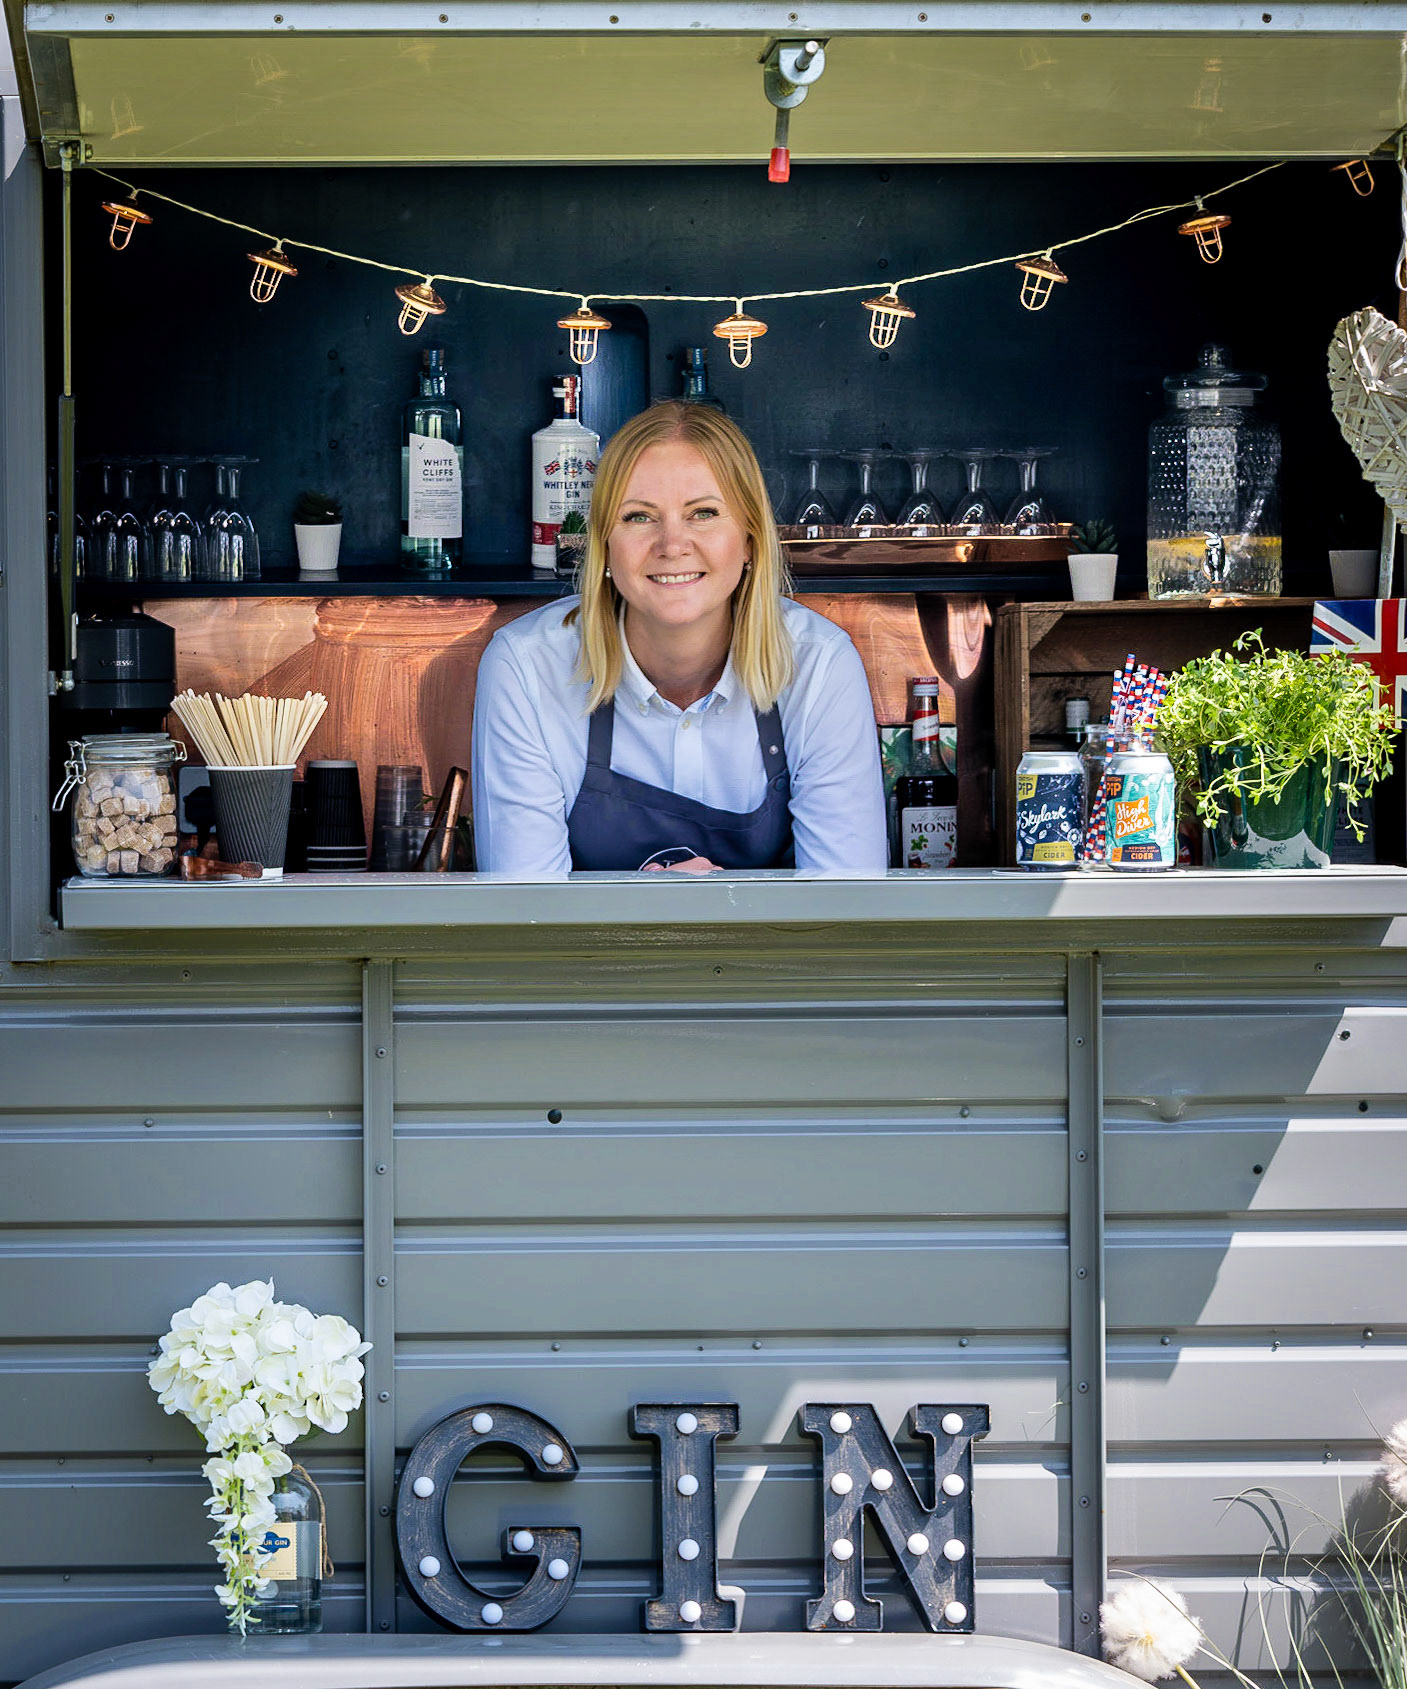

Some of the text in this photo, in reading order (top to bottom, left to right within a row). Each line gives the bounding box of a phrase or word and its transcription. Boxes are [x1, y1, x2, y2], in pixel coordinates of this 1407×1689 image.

[543, 481, 579, 489] WHITLEY
[1020, 803, 1068, 834] Skylark
[1116, 799, 1147, 820] High
[1116, 816, 1151, 836] Diver
[396, 1401, 991, 1634] GIN
